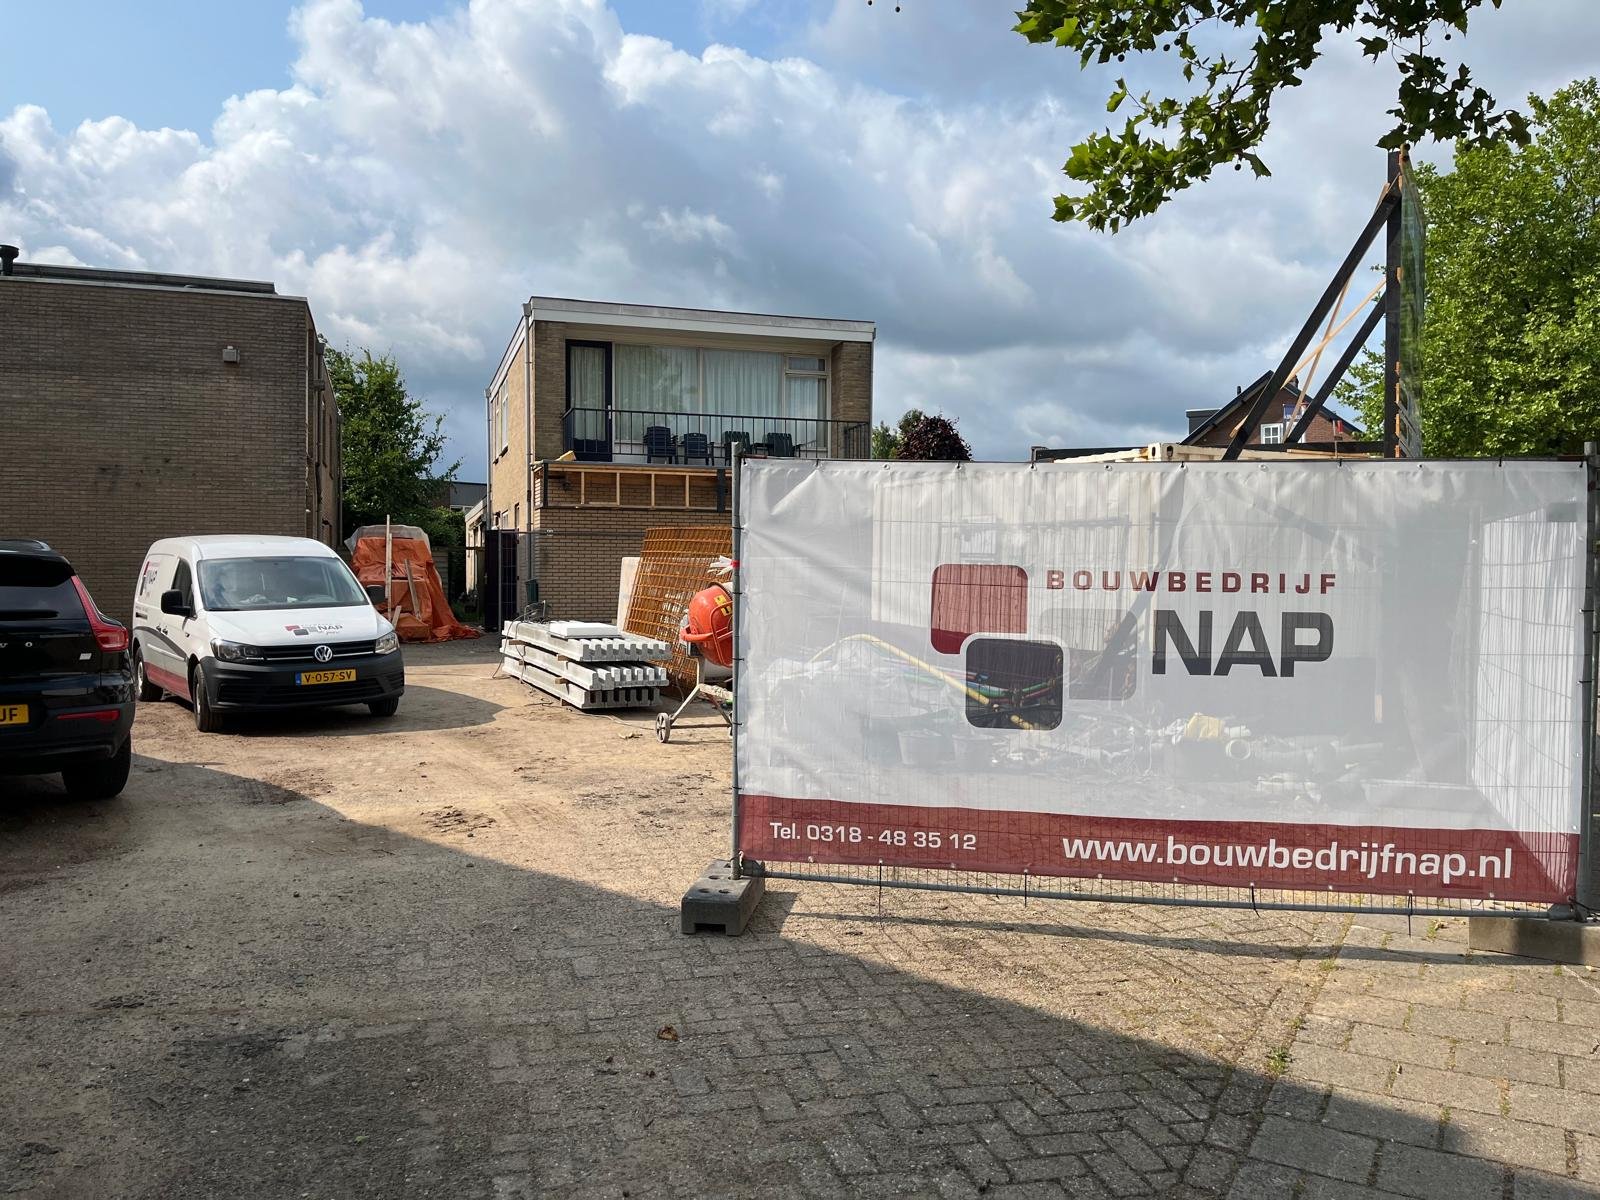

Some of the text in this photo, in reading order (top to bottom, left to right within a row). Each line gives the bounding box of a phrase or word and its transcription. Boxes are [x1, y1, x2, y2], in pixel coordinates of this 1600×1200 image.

[1046, 570, 1336, 595] BOUWBEDRIJF
[1152, 609, 1335, 678] NAP
[304, 671, 352, 683] V-057-SV
[769, 822, 801, 840] Tel.
[806, 824, 862, 843] 0318
[878, 829, 907, 847] 48
[913, 831, 942, 848] 35
[949, 833, 977, 850] 12
[1062, 836, 1513, 884] www.bouwbedrijfnap.nl
